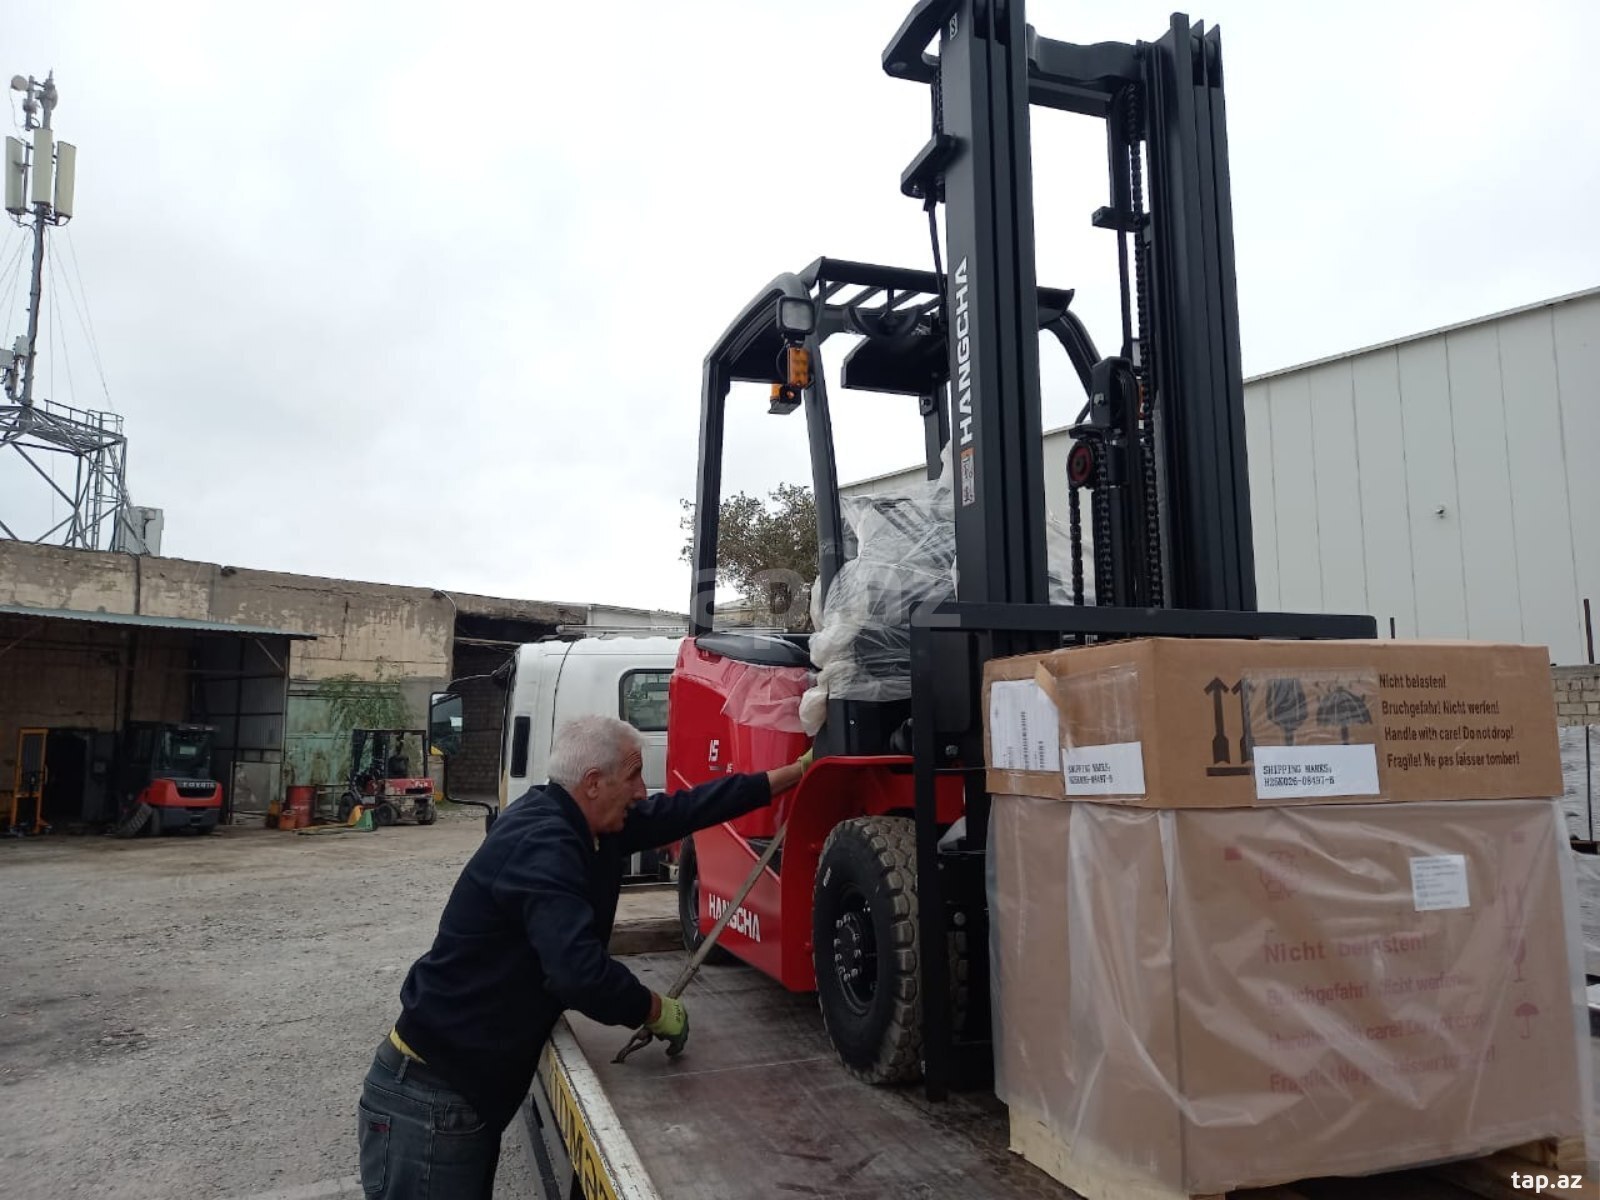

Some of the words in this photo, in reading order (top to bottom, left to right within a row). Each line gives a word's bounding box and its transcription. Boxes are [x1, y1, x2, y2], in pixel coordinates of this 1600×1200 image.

[954, 256, 974, 445] HANGCHA
[1379, 674, 1404, 688] Nicht
[1406, 674, 1446, 689] belasten!
[1382, 700, 1441, 717] Bruchgefahr!
[1443, 701, 1466, 715] Nicht
[1467, 700, 1500, 715] werfen!
[1385, 726, 1418, 741] Handle
[1418, 726, 1437, 741] with
[1439, 726, 1462, 740] care!
[1492, 726, 1514, 743] drop!
[1263, 764, 1301, 775] SHIPPING
[1387, 753, 1421, 771] Fragile!
[1424, 753, 1436, 767] Ne
[1438, 755, 1454, 770] pas
[1456, 752, 1485, 766] laisser
[1486, 751, 1520, 766] tomber!
[1264, 941, 1325, 964] Nicht
